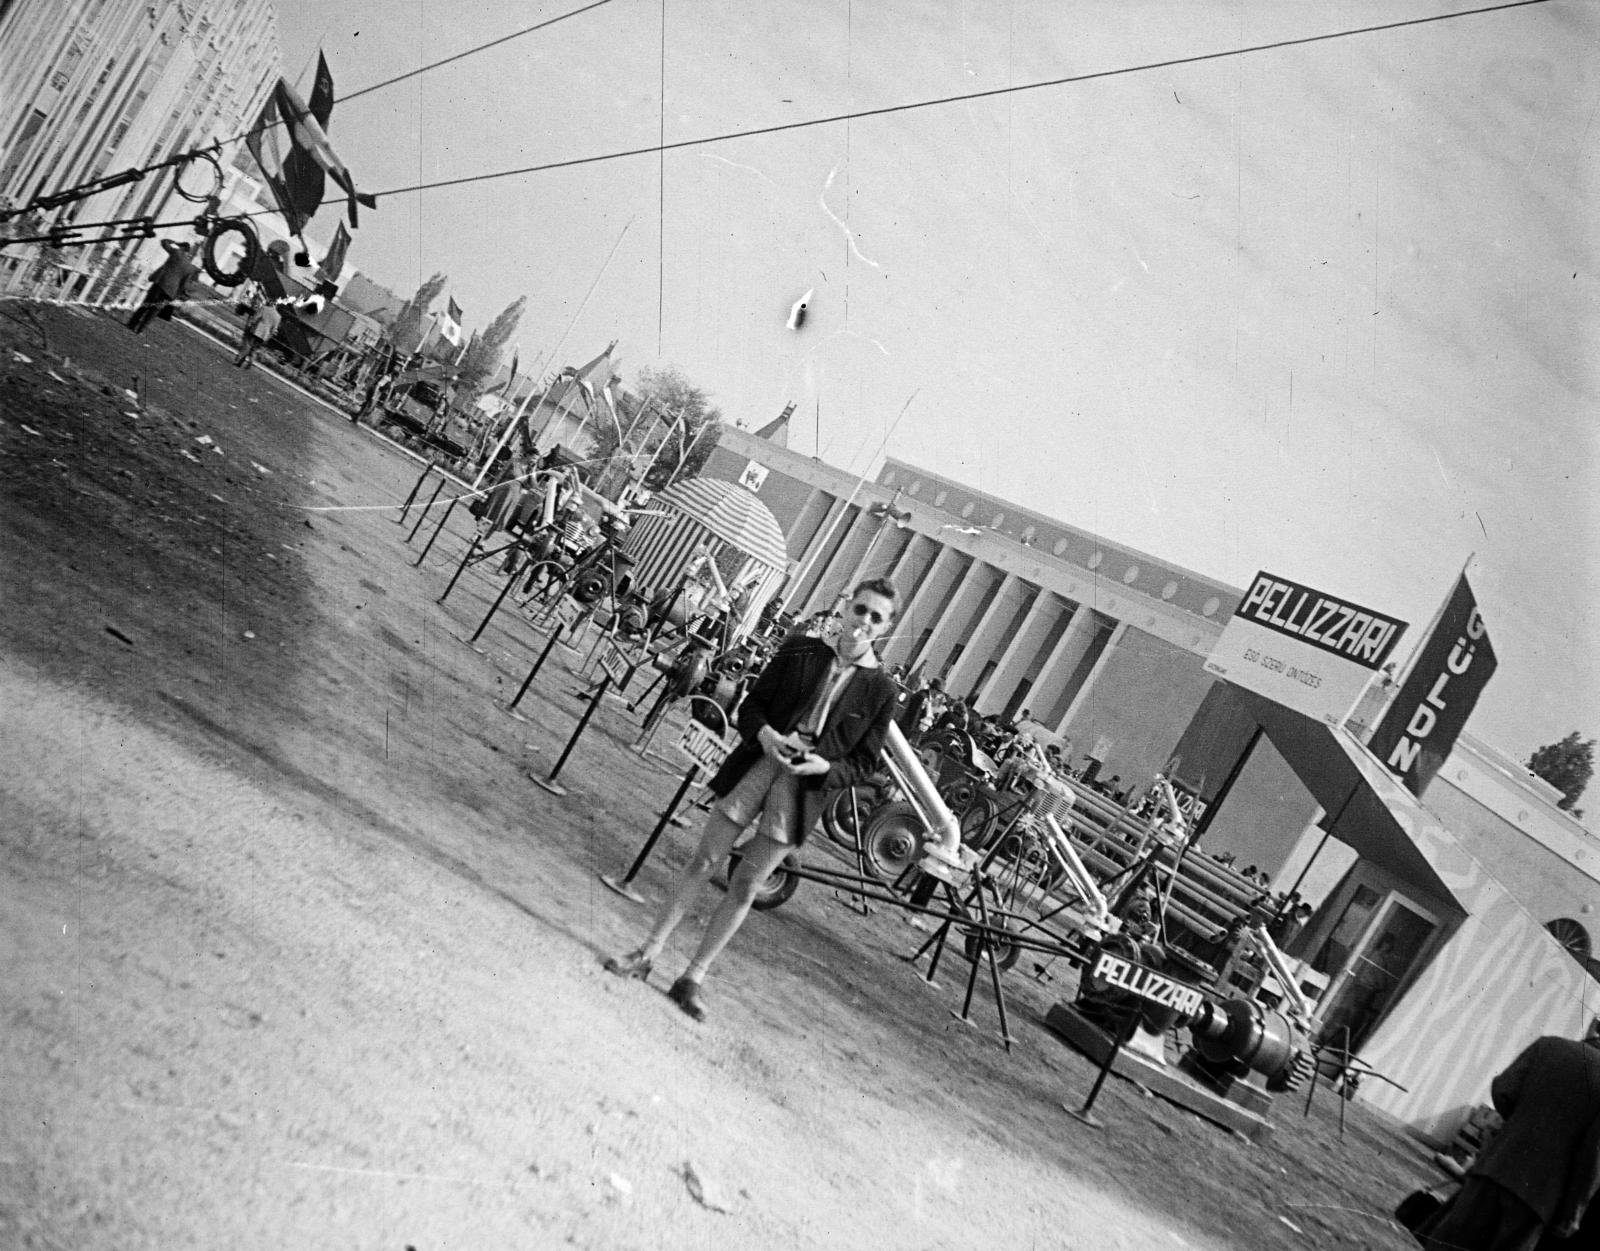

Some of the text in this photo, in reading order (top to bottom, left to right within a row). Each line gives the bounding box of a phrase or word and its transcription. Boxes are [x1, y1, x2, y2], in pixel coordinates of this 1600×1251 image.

[1241, 577, 1397, 663] PELLIZZARI
[1387, 606, 1486, 782] GÜLDN
[1093, 952, 1204, 1017] PELLIZZARI
